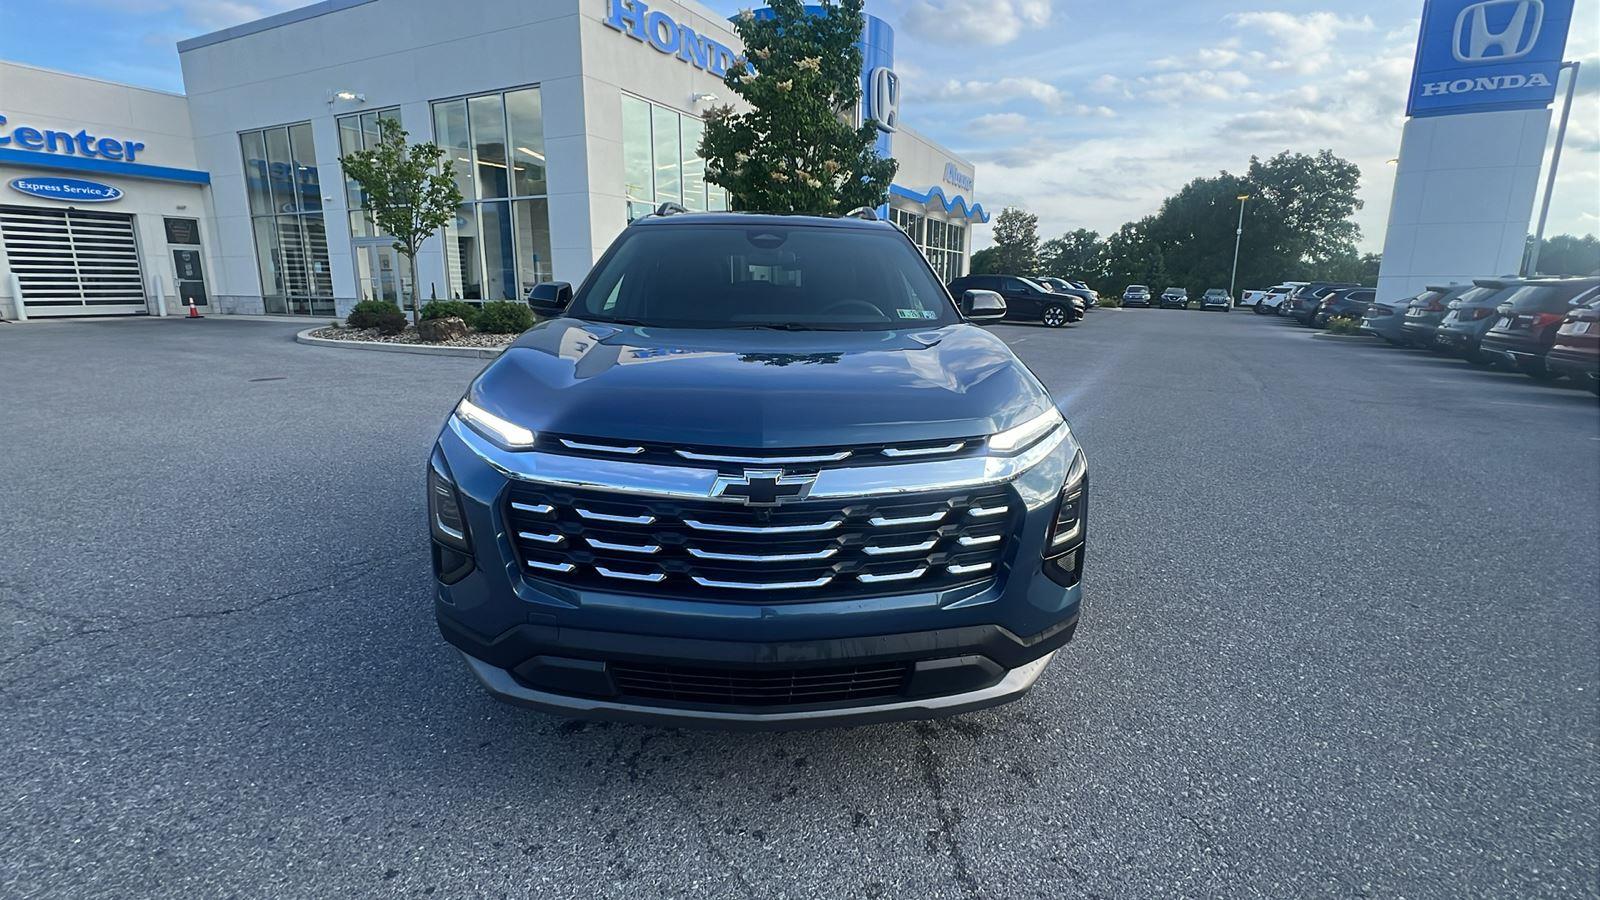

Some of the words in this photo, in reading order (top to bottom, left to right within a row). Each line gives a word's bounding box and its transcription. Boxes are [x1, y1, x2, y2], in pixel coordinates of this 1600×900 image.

[1421, 73, 1552, 97] HONDA
[18, 181, 61, 192] Express
[63, 184, 102, 195] Service
